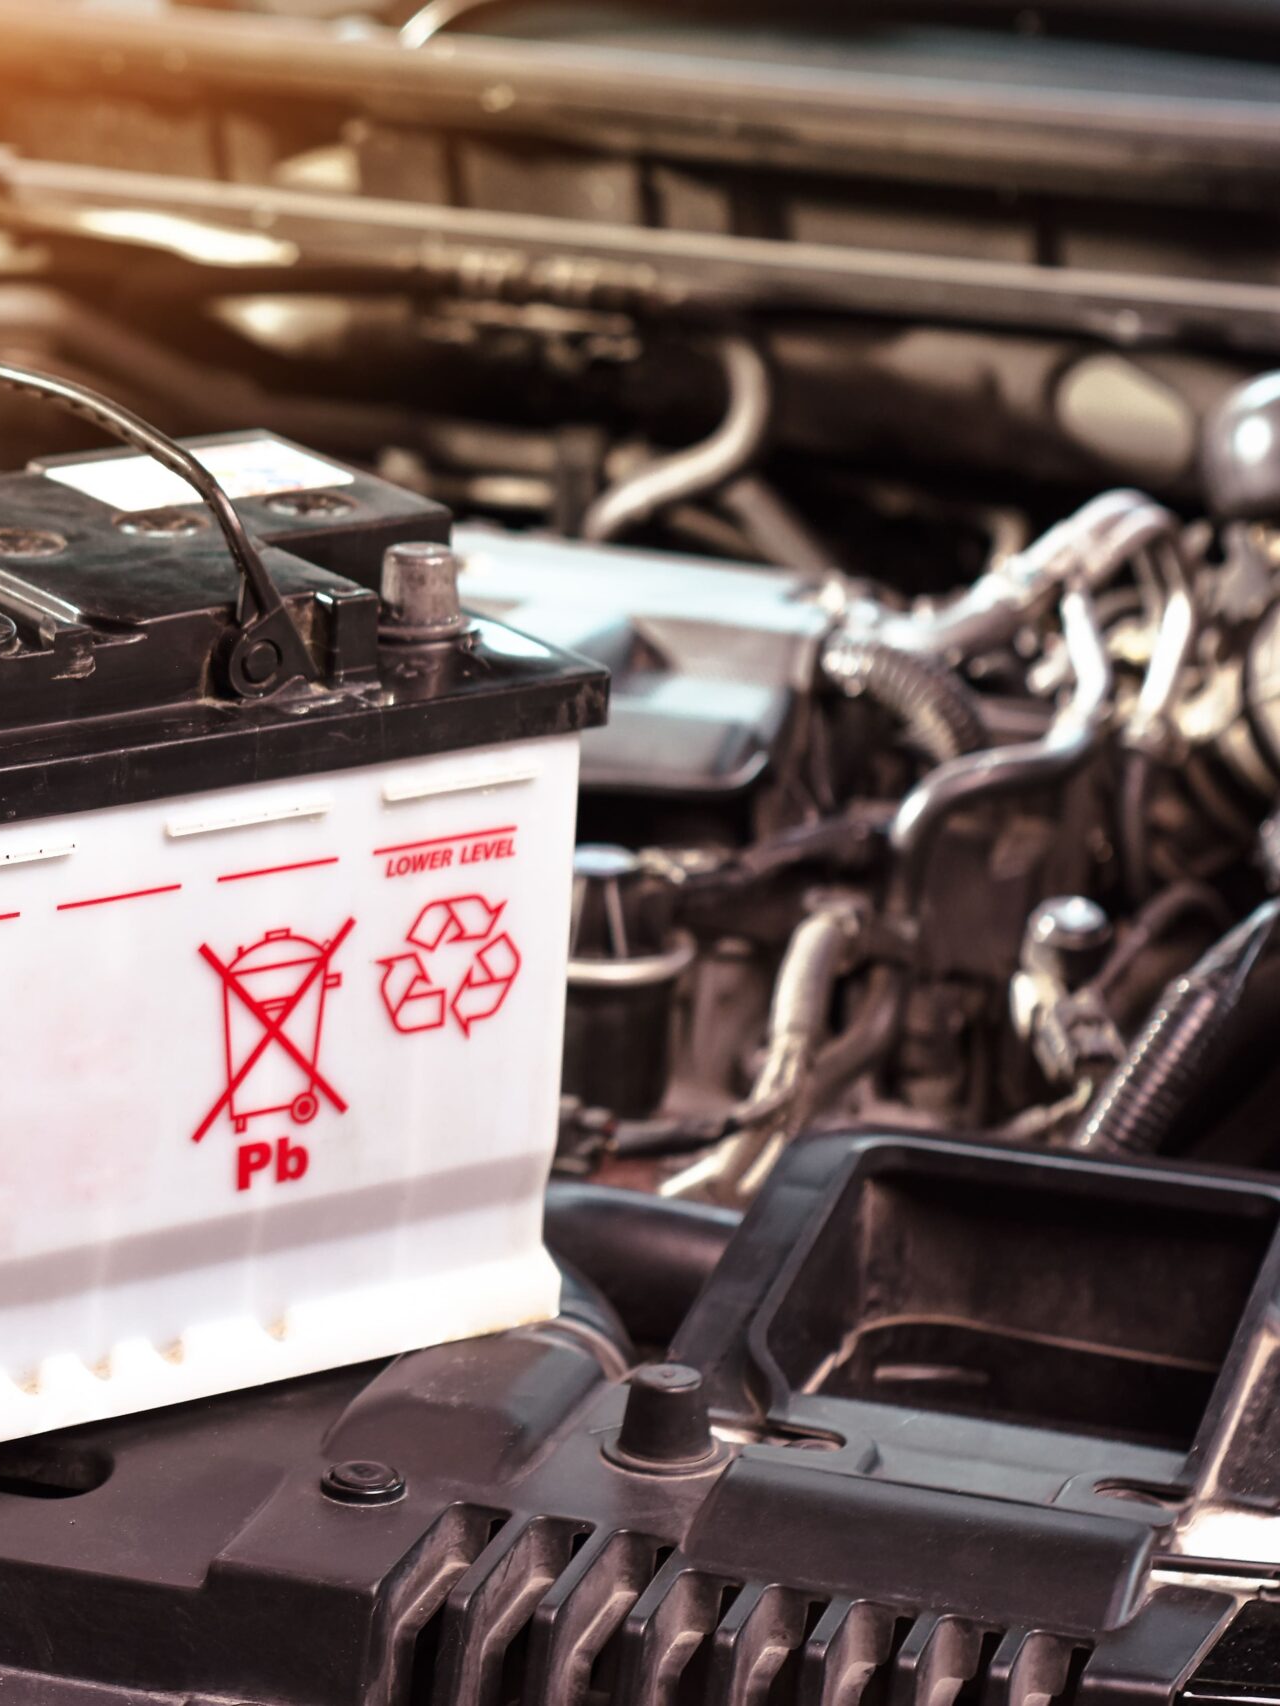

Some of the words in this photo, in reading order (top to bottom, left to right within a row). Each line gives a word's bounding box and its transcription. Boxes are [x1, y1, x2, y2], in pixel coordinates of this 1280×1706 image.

[385, 847, 453, 878] LOWER
[459, 838, 516, 865] LEVEL
[237, 1136, 309, 1192] Pb
